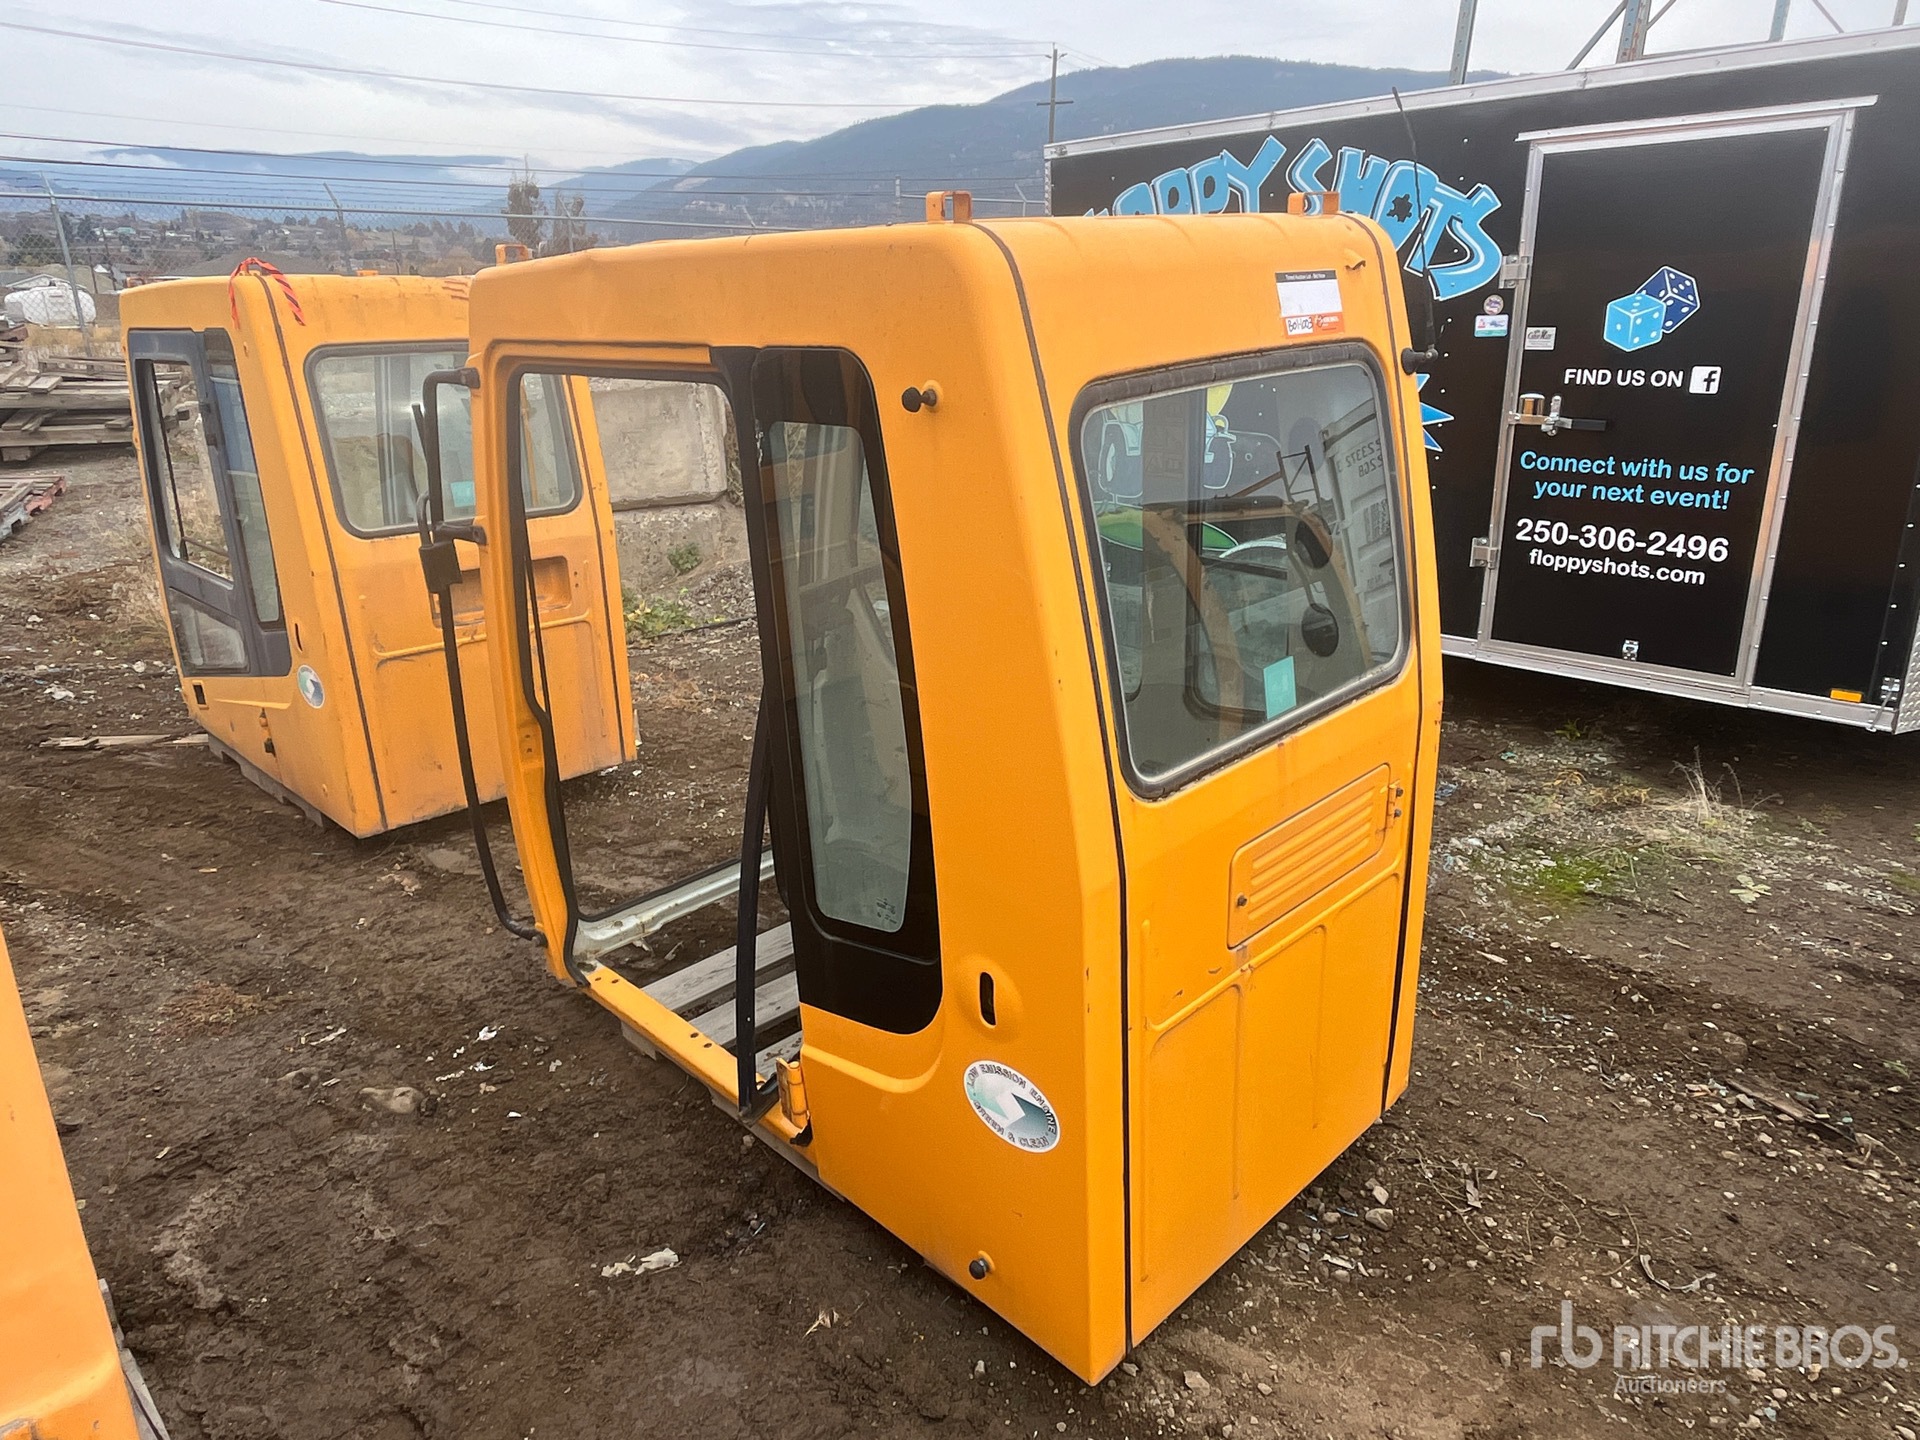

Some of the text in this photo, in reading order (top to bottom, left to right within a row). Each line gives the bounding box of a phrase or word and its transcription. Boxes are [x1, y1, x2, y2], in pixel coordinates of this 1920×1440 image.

[1564, 368, 1612, 386] FIND
[1616, 369, 1646, 387] US
[1650, 370, 1684, 388] ON
[1520, 451, 1755, 484] Connect with us for
[1533, 480, 1730, 510] your next event!
[1515, 518, 1730, 563] 250-306-2496
[1529, 548, 1706, 586] floppyshots.com
[1017, 1135, 1050, 1149] CLEAN
